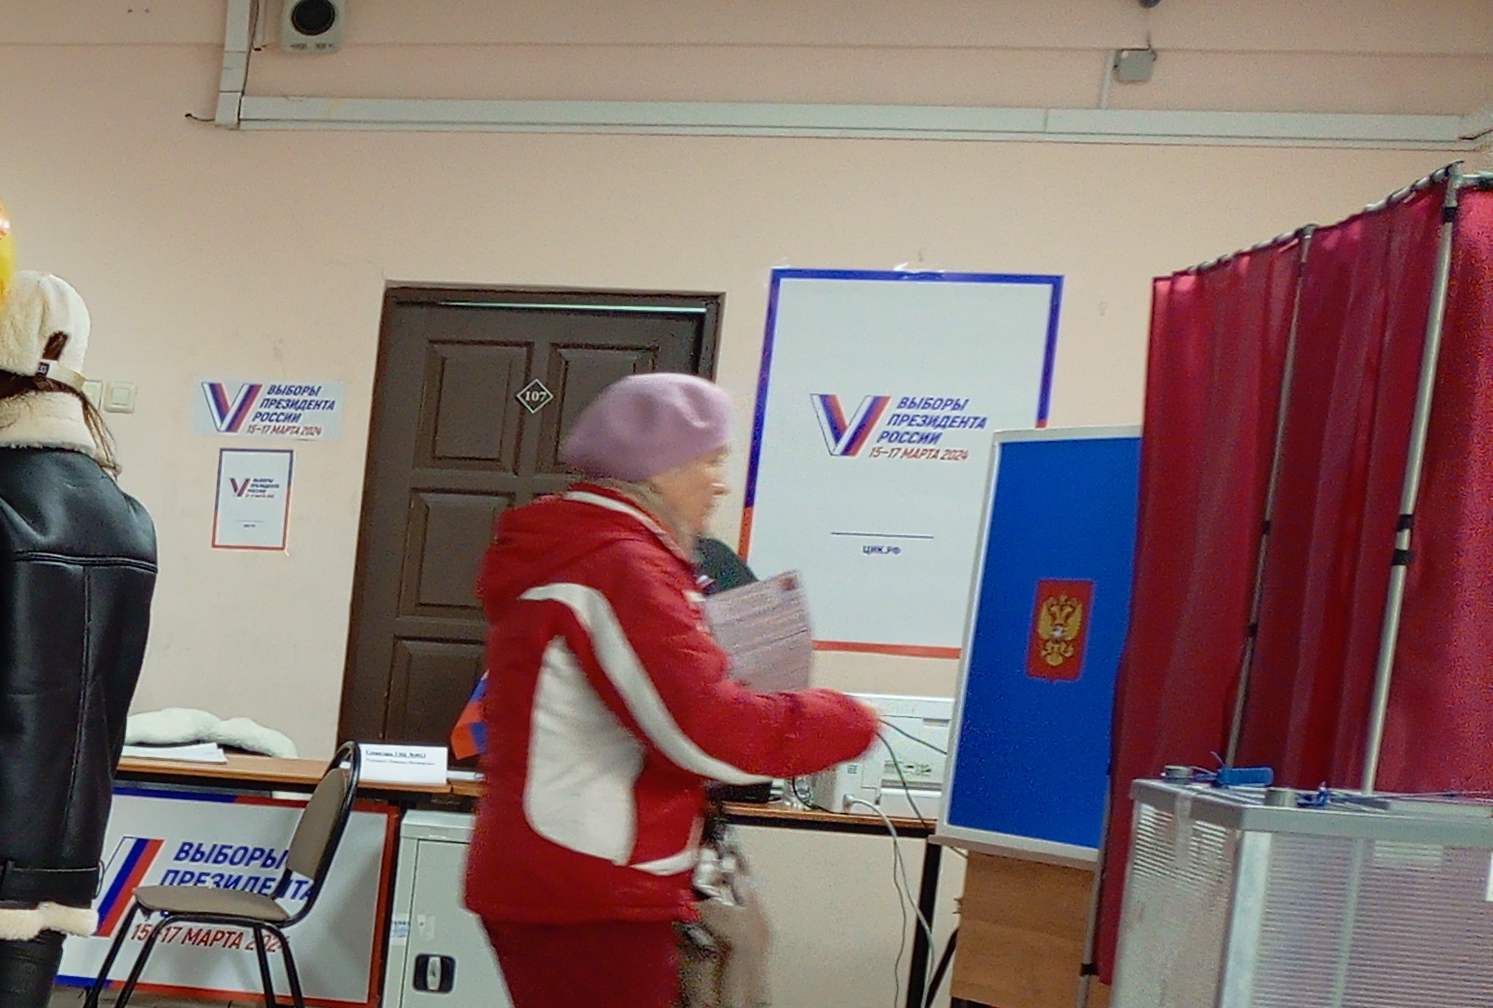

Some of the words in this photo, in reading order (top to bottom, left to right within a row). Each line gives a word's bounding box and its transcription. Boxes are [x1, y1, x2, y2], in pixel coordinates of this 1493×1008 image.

[267, 384, 321, 396] ВЫБОРЫ
[525, 391, 547, 402] 107
[259, 398, 336, 411] ПРЕЗИДЕНТА
[896, 396, 969, 411] ВЫБОРЫ
[252, 412, 302, 423] РОССИИ
[886, 414, 988, 430] ПРЕЗИДЕНТА
[270, 425, 300, 435] МАРТА
[300, 426, 322, 436] 2024
[877, 431, 943, 445] РОССИИ
[902, 447, 940, 460] МАРТА
[940, 449, 969, 460] 2024
[863, 545, 901, 555] ЦИК.РФ
[173, 841, 289, 869] ВЫБОРЫ
[181, 928, 244, 949] МАРТА
